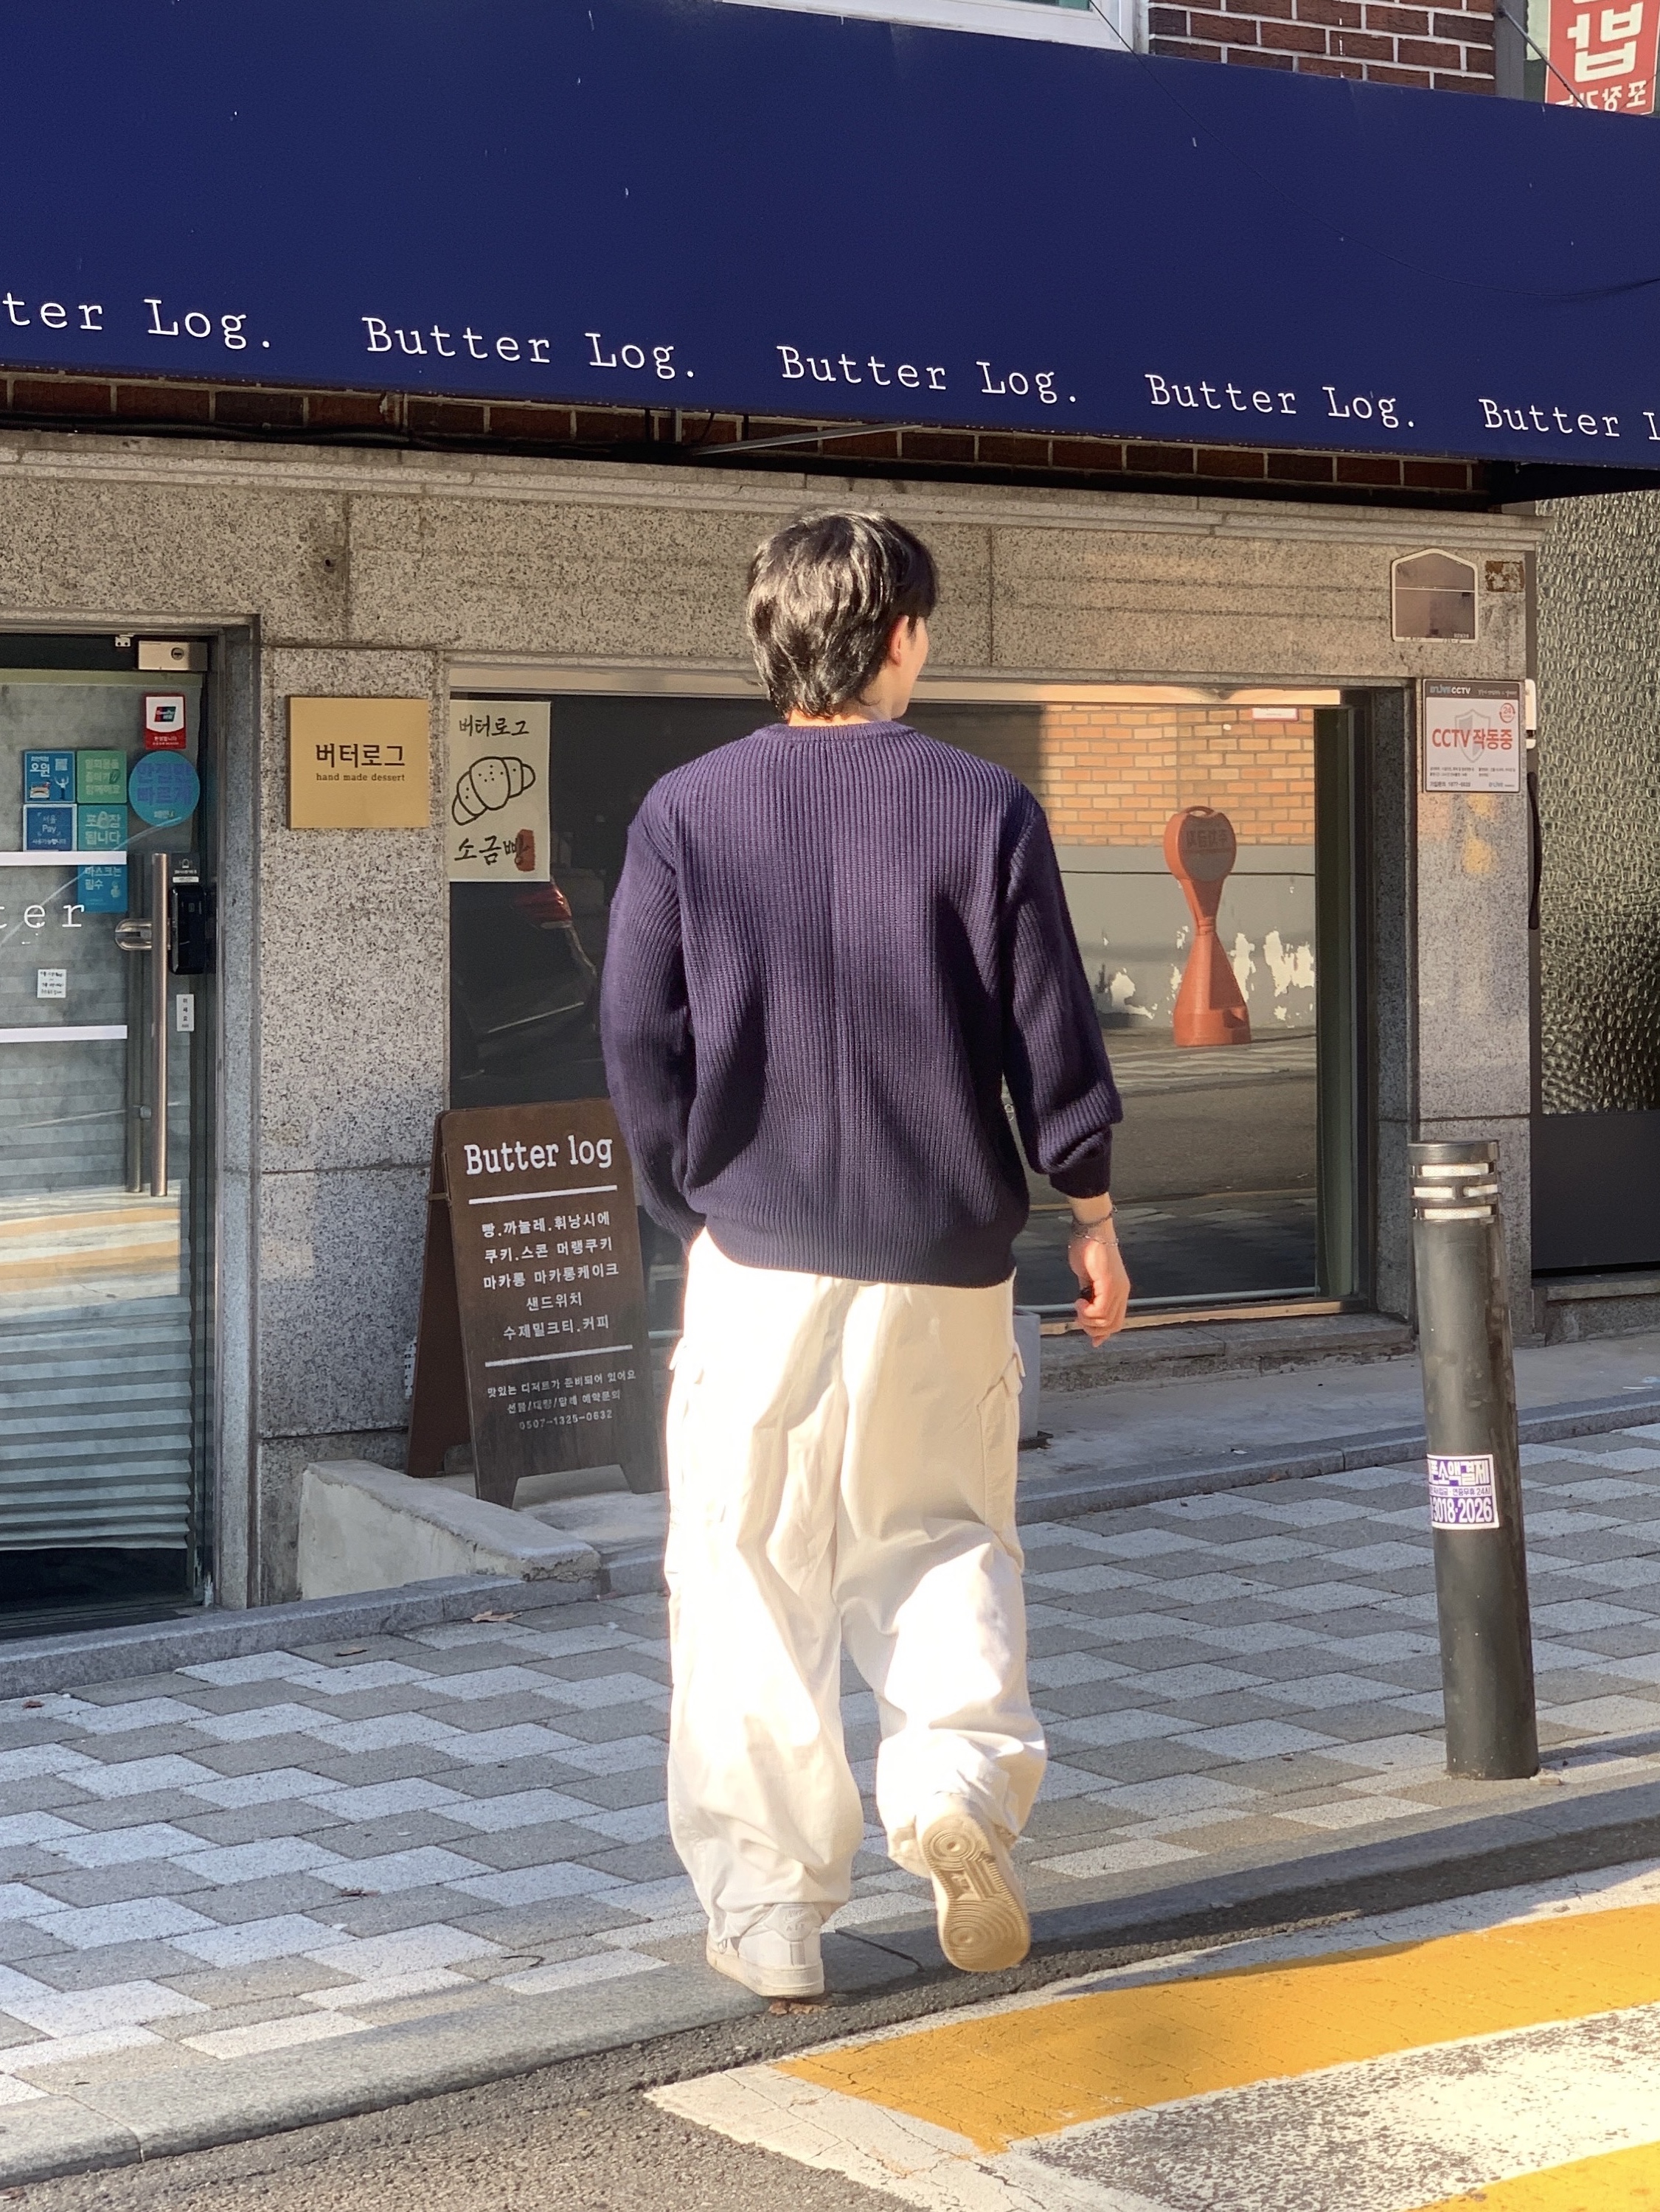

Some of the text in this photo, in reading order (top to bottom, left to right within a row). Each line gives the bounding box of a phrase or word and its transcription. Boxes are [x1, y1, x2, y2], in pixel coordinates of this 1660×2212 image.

[144, 299, 270, 350] Log.
[361, 316, 695, 380] Butter Log.
[776, 345, 1077, 404] Butter Log.
[1145, 374, 1414, 428] Butter Log.
[1478, 398, 1620, 437] Butter
[1451, 686, 1471, 695] CCTV
[459, 714, 529, 737] 버터로그
[1431, 728, 1513, 751] CCTV 작동중
[316, 742, 406, 768] 버터로그
[316, 773, 406, 782] hand made dessert
[42, 824, 57, 834] Pay
[464, 1135, 613, 1175] Butter log
[485, 1237, 612, 1264] 쿠키.스콘 머랭쿠키
[484, 1263, 619, 1290] 마카롱 마카롱케이크
[526, 1292, 583, 1312] 샌드위치
[487, 1369, 636, 1398] 맛있는 디저트가 준비되어 있어요
[1453, 1487, 1476, 1496] 연중무휴
